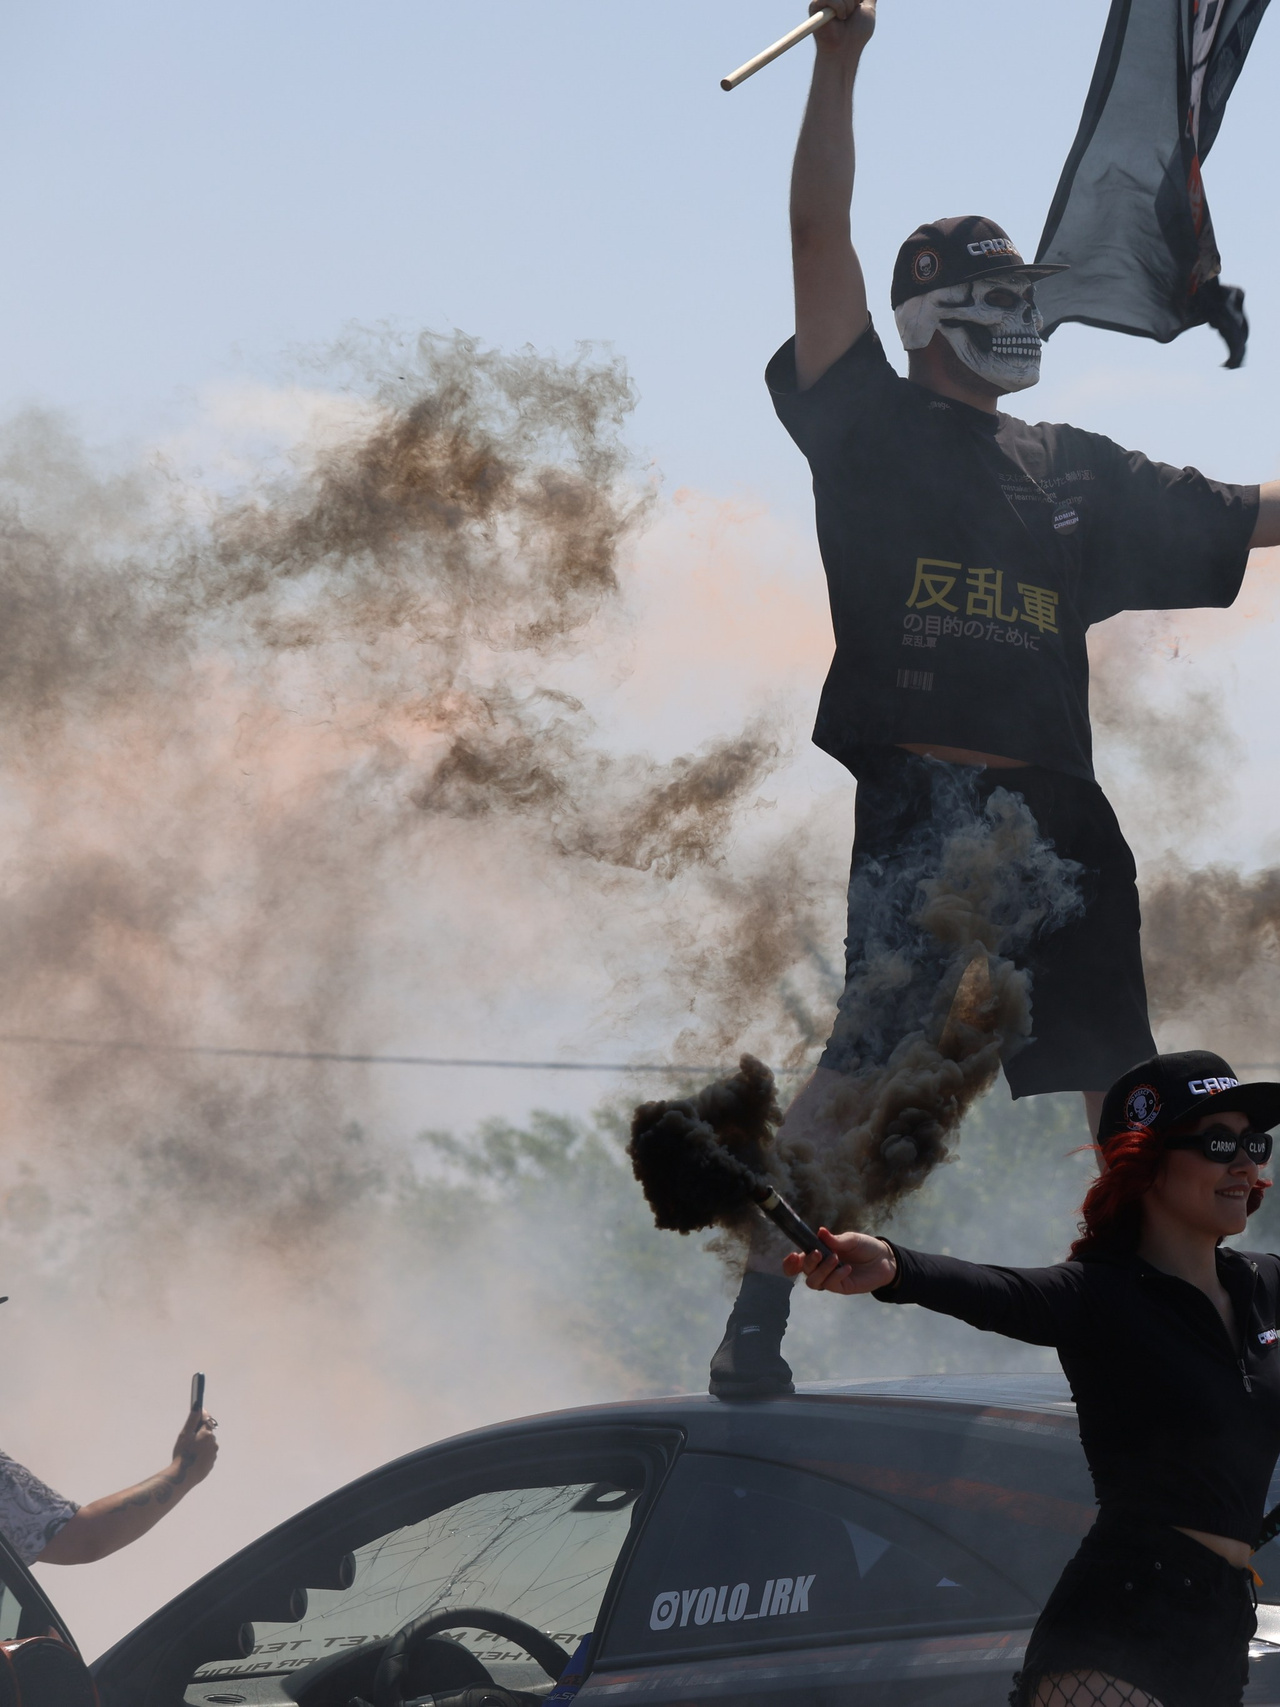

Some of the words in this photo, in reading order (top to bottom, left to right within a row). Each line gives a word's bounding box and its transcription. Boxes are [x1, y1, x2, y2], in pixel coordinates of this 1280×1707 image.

[1054, 511, 1076, 522] ADMIN
[905, 557, 1059, 634] 反乱軍
[903, 613, 1041, 651] の目的のために
[1210, 1140, 1237, 1153] CARBON
[1249, 1141, 1266, 1153] CLUB
